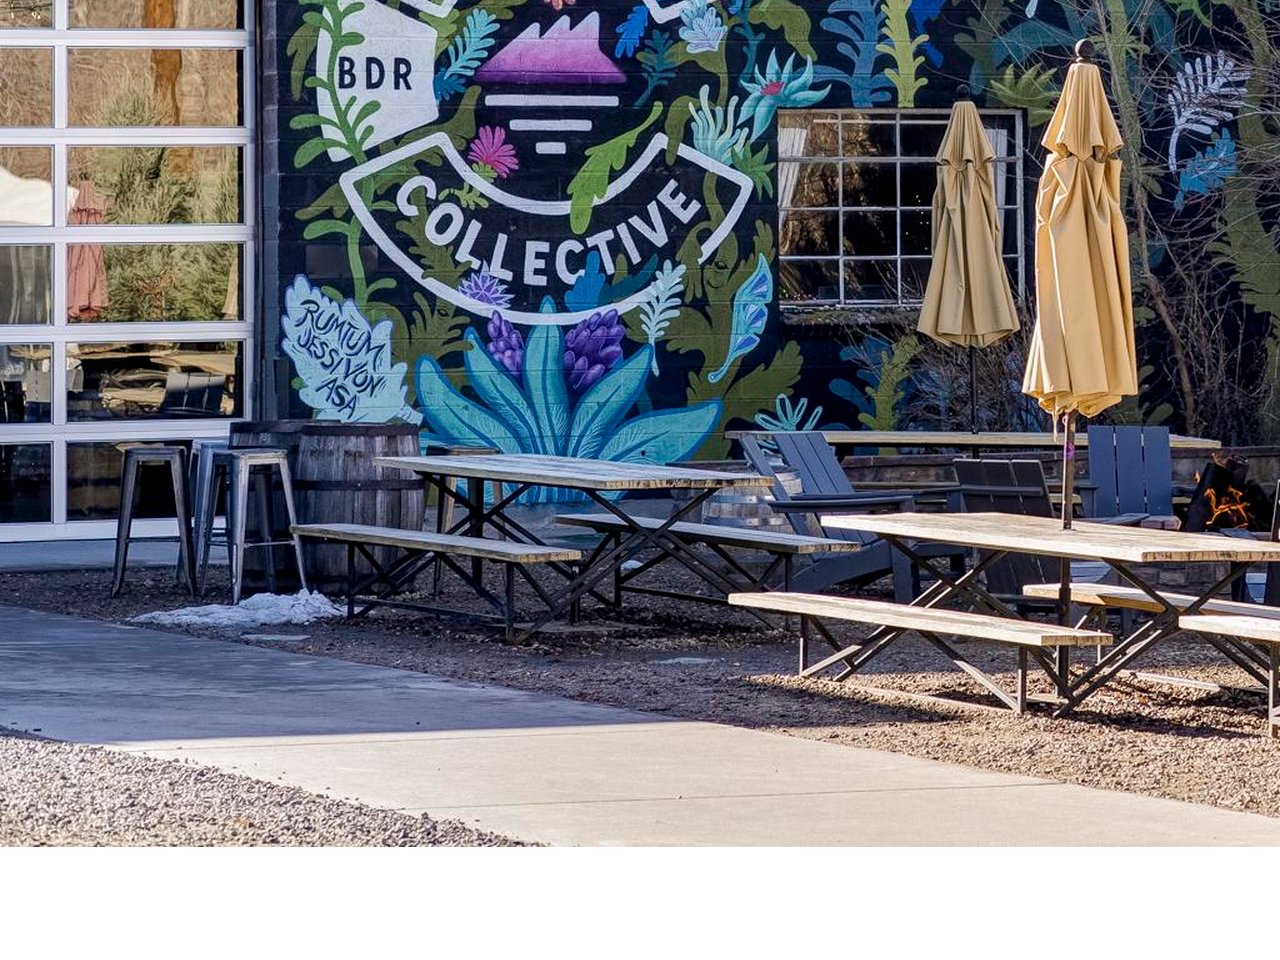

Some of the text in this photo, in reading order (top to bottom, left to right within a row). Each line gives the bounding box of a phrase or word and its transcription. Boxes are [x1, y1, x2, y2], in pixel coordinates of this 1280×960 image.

[338, 55, 412, 90] BDR
[396, 175, 701, 286] COLLECTIVE
[315, 376, 358, 420] ASA
